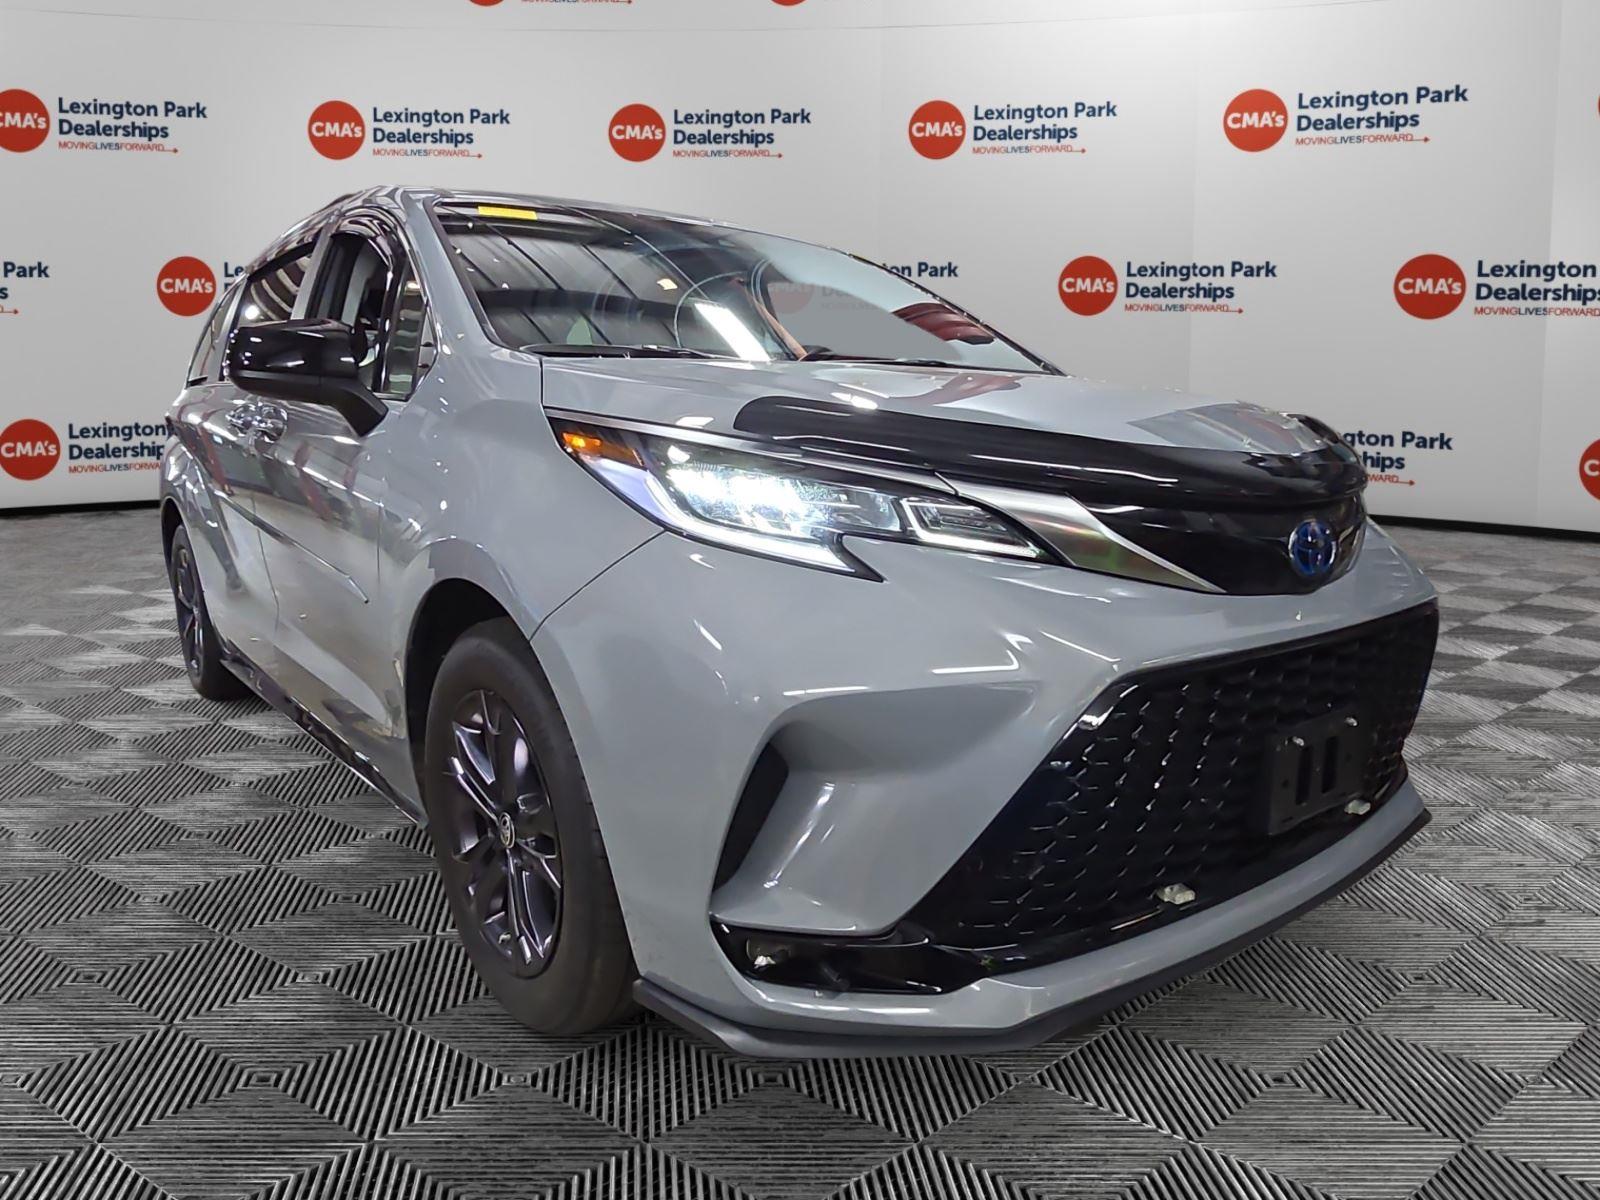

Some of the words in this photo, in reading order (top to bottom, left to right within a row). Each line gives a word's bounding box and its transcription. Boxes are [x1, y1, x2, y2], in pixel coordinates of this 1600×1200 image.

[1298, 91, 1409, 112] Lexington
[1416, 84, 1468, 104] Park
[58, 97, 158, 119] Lexington
[164, 100, 207, 119] Park
[373, 107, 463, 127] Lexington
[470, 108, 510, 125] Park
[974, 104, 1067, 123] Lexington
[1074, 101, 1117, 118] Park
[673, 109, 764, 128] Lexington
[771, 108, 811, 124] Park
[1227, 111, 1285, 129] CMA's
[1297, 111, 1420, 132] Dealerships
[58, 119, 169, 140] Dealerships
[312, 121, 363, 139] CMA's
[373, 128, 474, 146] Dealerships
[612, 124, 663, 141] CMA's
[673, 129, 774, 146] Dealerships
[911, 121, 963, 138] CMA's
[973, 125, 1077, 143] Dealerships
[3, 261, 50, 278] Park
[917, 261, 959, 278] Park
[1126, 261, 1225, 281] Lexington
[1231, 261, 1277, 278] Park
[1477, 259, 1597, 282] Lexington
[160, 278, 214, 294] CMA's
[1062, 277, 1115, 293] CMA's
[1125, 282, 1235, 303] Dealerships
[1398, 277, 1462, 295] CMA's
[68, 422, 166, 441] Lexington
[1401, 430, 1453, 450] Park
[1, 441, 57, 458] CMA's
[68, 441, 165, 461] Dealership
